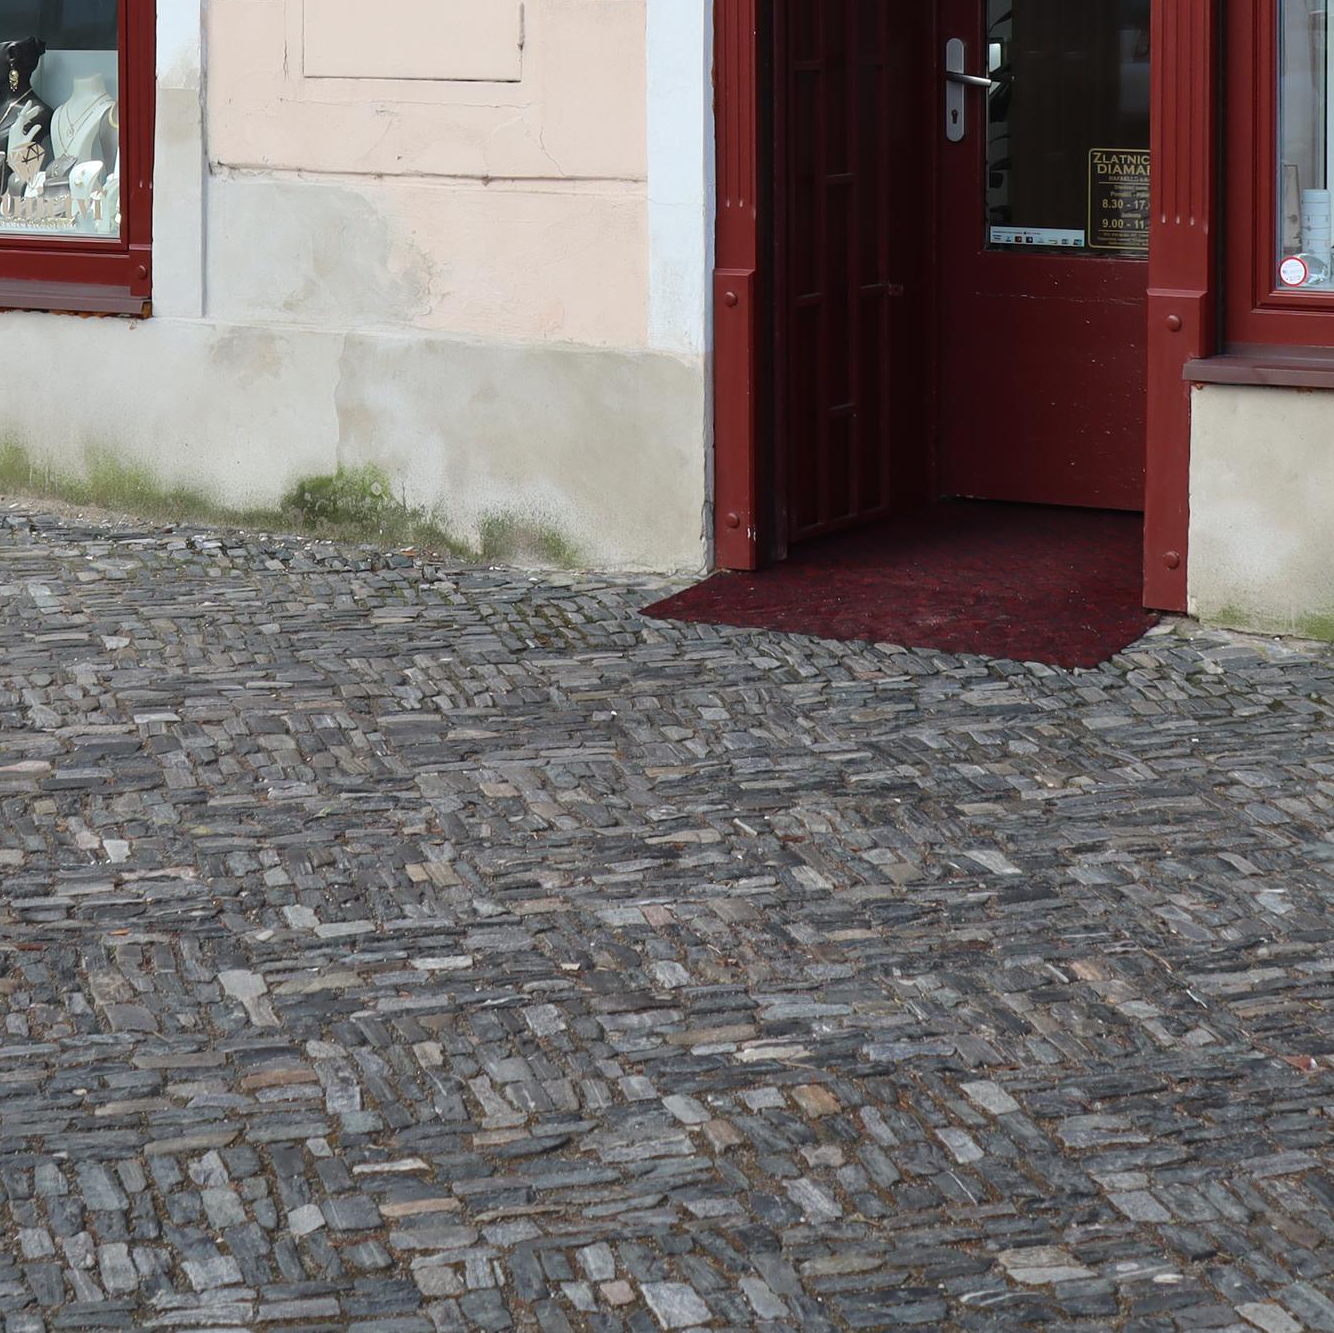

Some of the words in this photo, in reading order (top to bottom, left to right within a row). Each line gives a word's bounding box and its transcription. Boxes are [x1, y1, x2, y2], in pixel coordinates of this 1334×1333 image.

[1102, 198, 1124, 209] 8.30
[1133, 200, 1150, 211] 17.
[1102, 218, 1124, 229] 9.00
